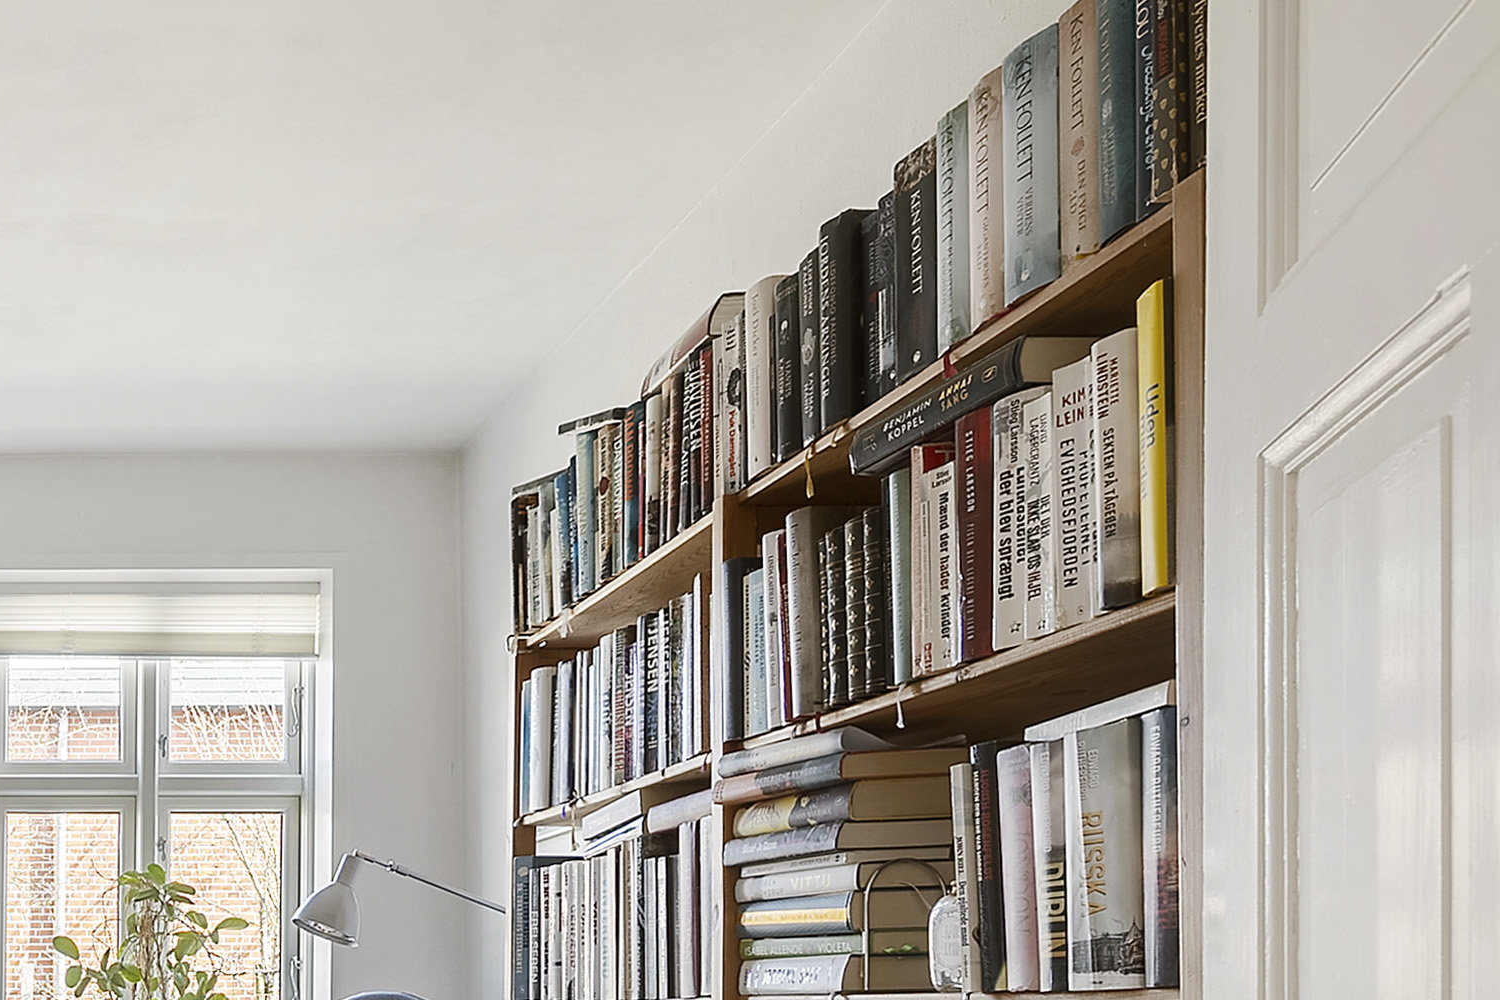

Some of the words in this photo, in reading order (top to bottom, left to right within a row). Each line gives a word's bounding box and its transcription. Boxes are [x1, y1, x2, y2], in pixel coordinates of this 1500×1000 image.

[1069, 11, 1083, 57] KEN
[1015, 52, 1032, 100] KEN
[1069, 53, 1085, 134] FOLLETT
[1194, 58, 1207, 126] marked
[974, 88, 988, 136] KEN
[940, 122, 952, 167] KEN
[1015, 97, 1033, 188] FOLLETT
[975, 132, 989, 217] FOLLETT
[1076, 155, 1087, 192] DEN
[909, 186, 922, 228] KEN
[940, 165, 953, 246] FOLLETT
[819, 232, 830, 313] JORDENS
[910, 224, 923, 298] FOLLETT
[751, 318, 759, 357] Dicker
[820, 312, 831, 401] ARVINGER
[829, 314, 837, 367] FALCONES
[938, 374, 973, 400] ANNAS
[940, 388, 969, 412] SANG
[1095, 351, 1108, 420] LINDSTEIN
[1109, 356, 1118, 406] MARIETTE
[728, 408, 736, 429] Puk
[882, 398, 932, 432] BENJAMIN
[888, 415, 925, 441] KOPPEL
[1008, 398, 1020, 424] Stieg
[1038, 412, 1047, 444] DAVID
[1056, 406, 1085, 429] LEIN
[1145, 381, 1159, 448] Uden
[726, 426, 738, 480] Damsgård
[965, 429, 974, 461] STIEG
[1009, 424, 1020, 463] Larsson
[1028, 416, 1039, 485] LAGERCRANTZ
[1102, 426, 1113, 470] SEKTEN
[966, 464, 975, 512] LARSSON
[998, 468, 1013, 497] der
[1102, 469, 1118, 488] PÅ
[938, 492, 949, 530] Mænd
[998, 498, 1014, 535] blev
[1026, 497, 1040, 524] IKKE
[1039, 493, 1050, 516] DET
[1059, 436, 1078, 590] EVIGHEDSFJORDEN
[1103, 486, 1118, 539] TÅGEØEN
[939, 532, 949, 554] der
[1026, 553, 1040, 569] OS
[940, 556, 950, 590] hader
[996, 535, 1015, 602] sprængt
[1027, 569, 1040, 601] IHJEL
[940, 592, 951, 640] kvinder
[646, 626, 658, 693] JENSEN
[1086, 748, 1099, 788] EDWARD
[1150, 724, 1160, 774] EDWARD
[1150, 777, 1161, 854] RUTHERFURD
[1077, 809, 1107, 918] RUSSKA
[1043, 861, 1064, 957] DUBLIN
[744, 944, 769, 956] ISABEL
[769, 942, 803, 956] ALLENDE
[817, 941, 852, 953] VIOLETA
[960, 926, 969, 946] mand
